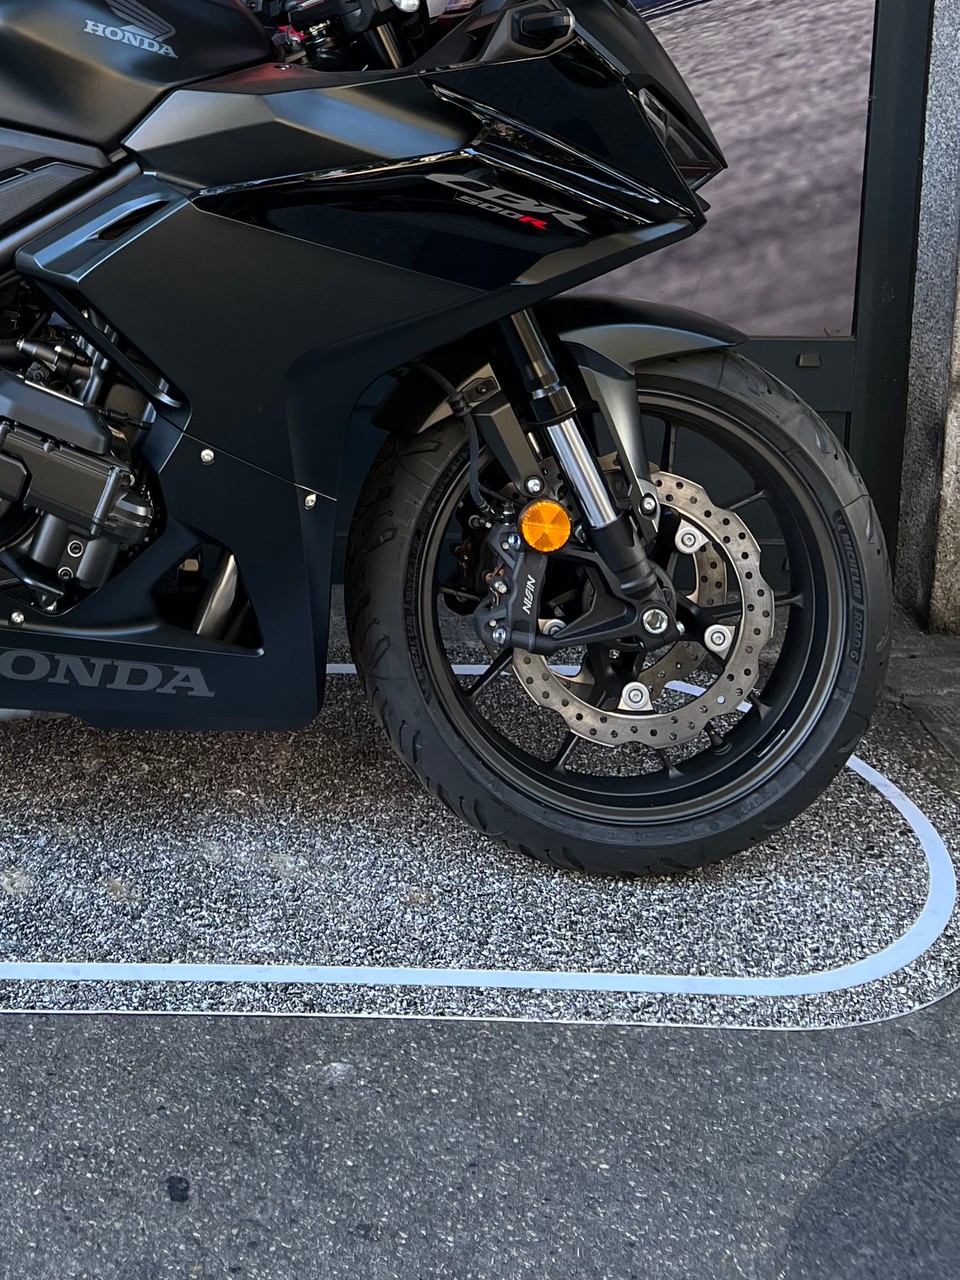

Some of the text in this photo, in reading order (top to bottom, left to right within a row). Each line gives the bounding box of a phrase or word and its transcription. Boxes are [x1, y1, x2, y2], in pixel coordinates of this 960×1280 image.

[83, 19, 179, 59] HONDA
[425, 173, 591, 235] CBR
[455, 195, 548, 231] 500R
[841, 534, 863, 598] MICHELIN
